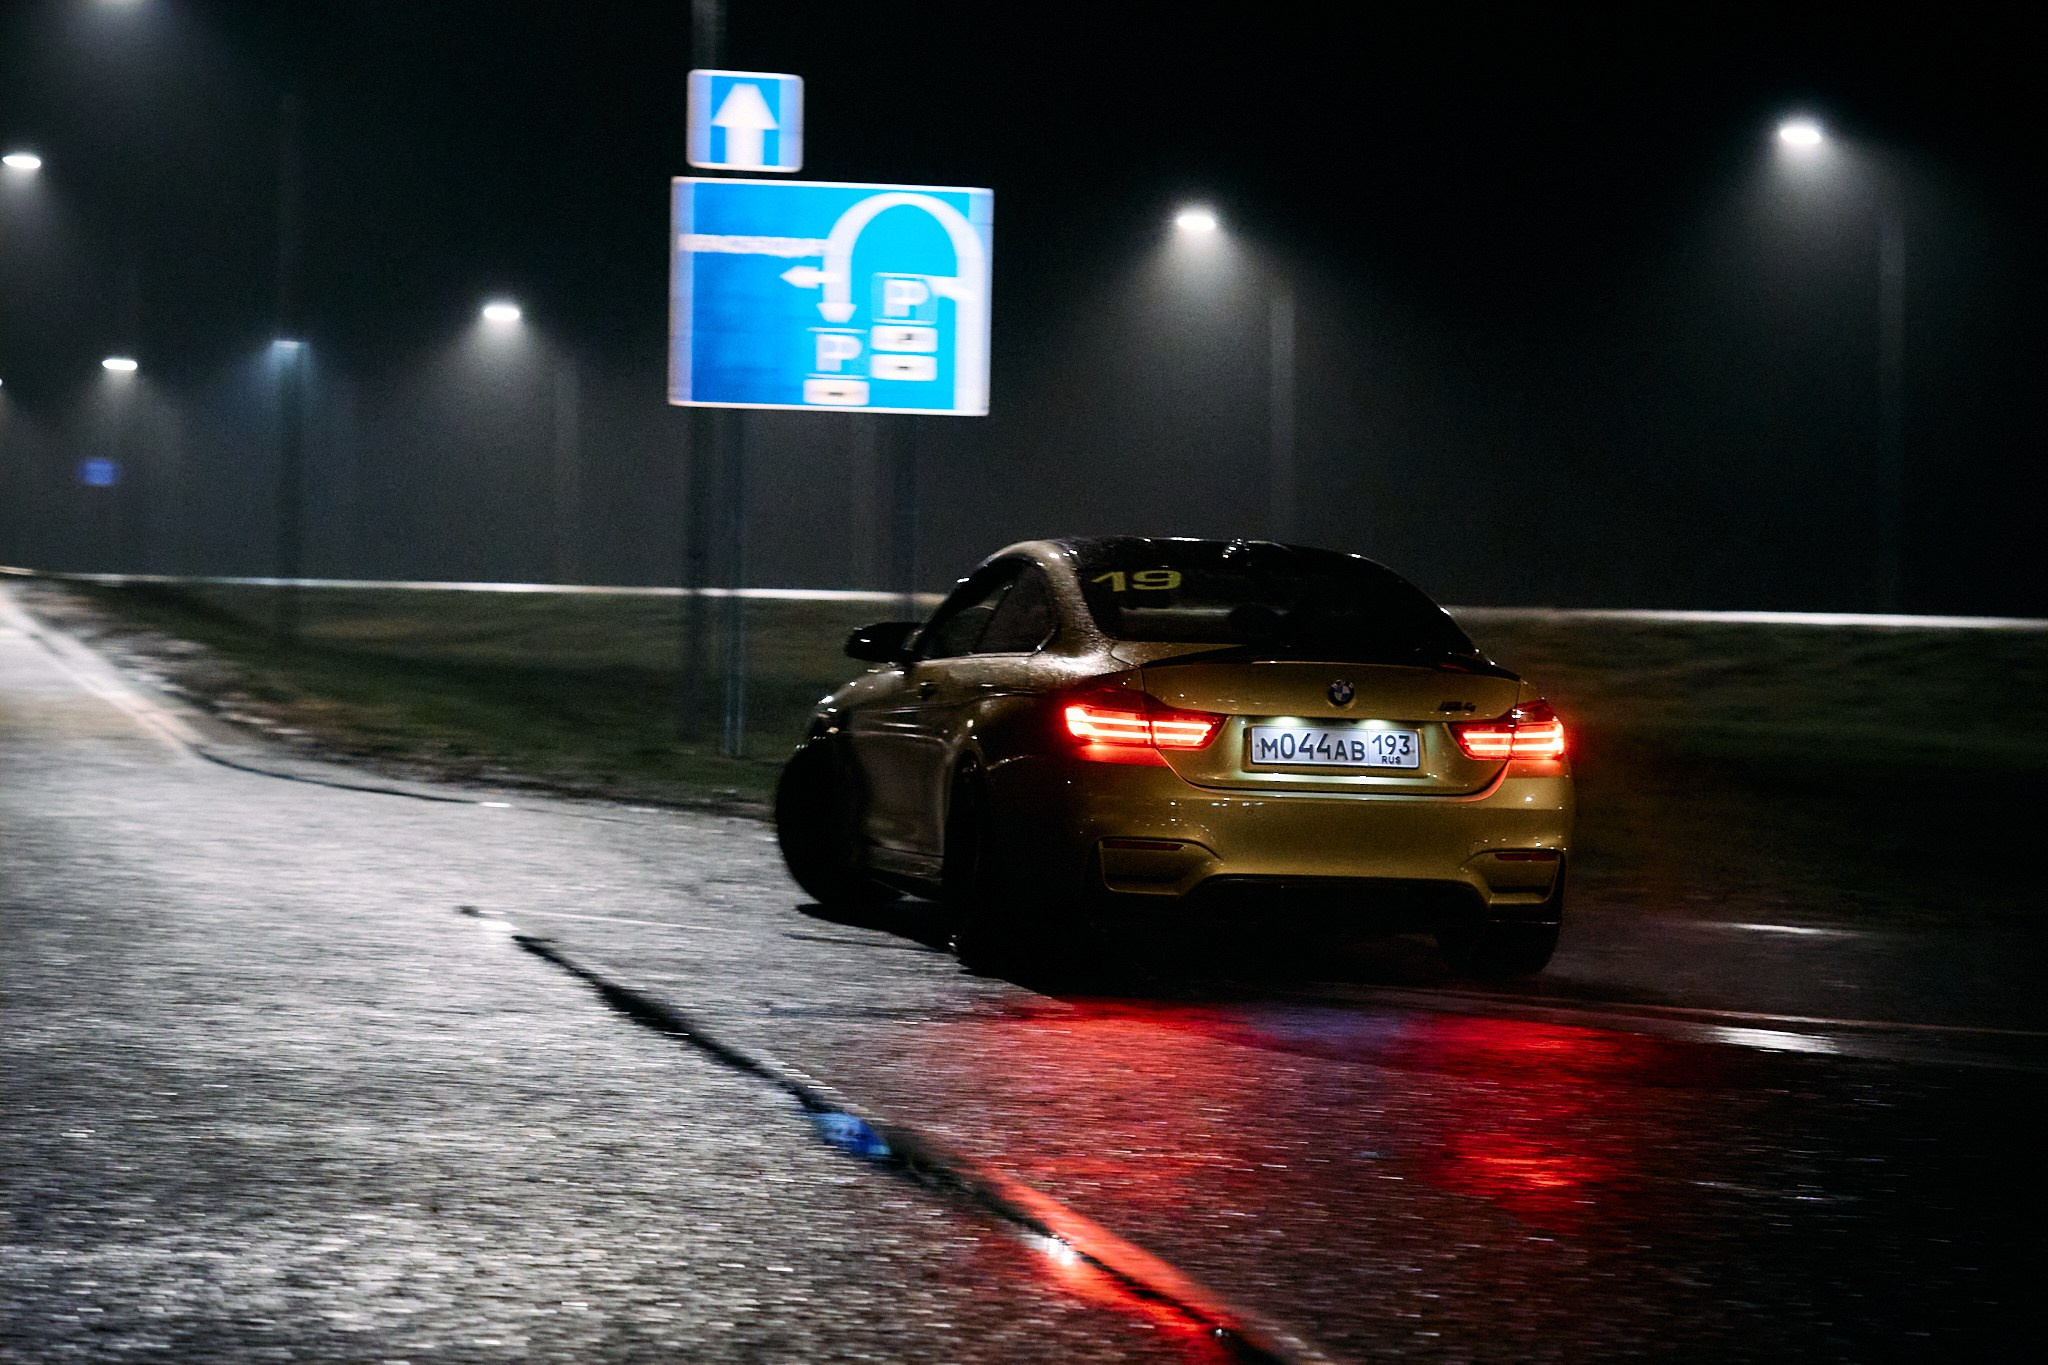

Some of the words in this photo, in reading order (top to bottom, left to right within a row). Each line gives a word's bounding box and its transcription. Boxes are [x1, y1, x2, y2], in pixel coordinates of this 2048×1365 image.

[883, 279, 930, 318] P
[816, 333, 863, 372] P
[1092, 569, 1182, 592] 19
[1371, 734, 1412, 756] 193
[1381, 755, 1401, 765] RUS
